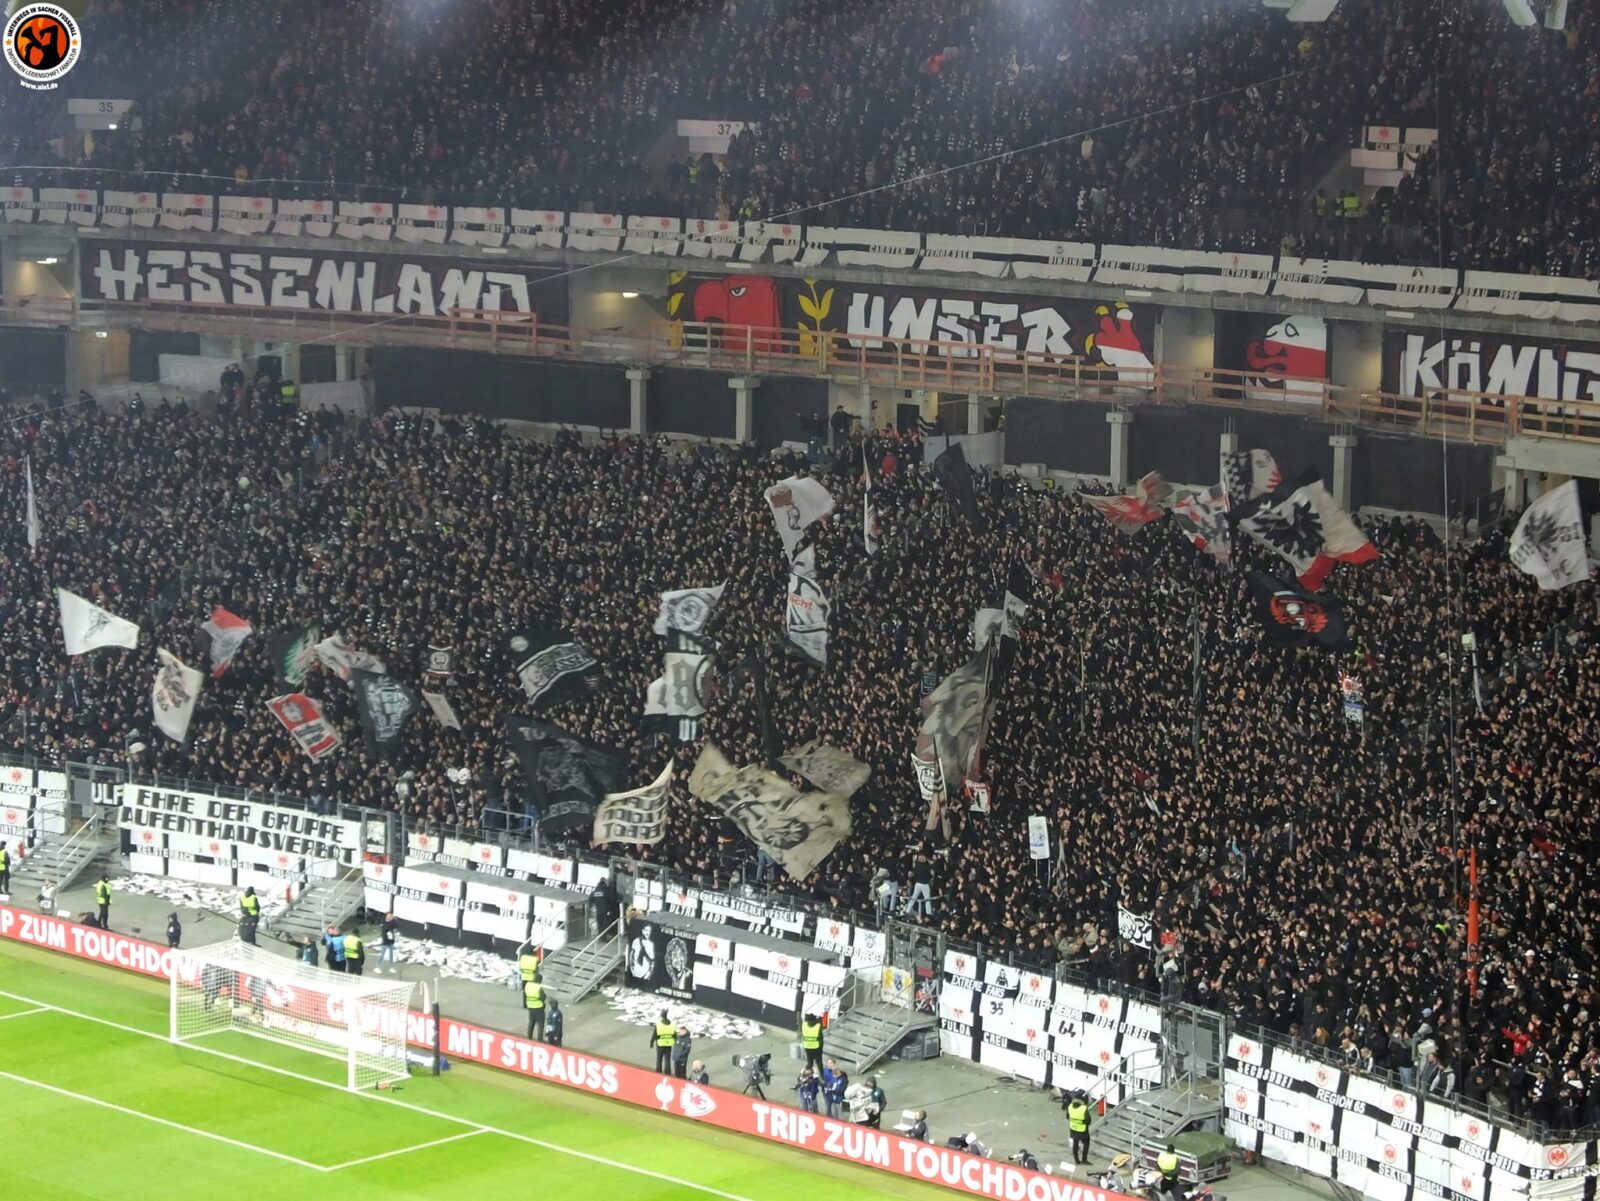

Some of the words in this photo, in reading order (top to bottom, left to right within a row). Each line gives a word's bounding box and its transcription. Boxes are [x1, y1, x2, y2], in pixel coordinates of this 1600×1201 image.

[98, 102, 114, 113] 35
[717, 123, 732, 136] 37
[1091, 258, 1122, 271] SZENE
[1129, 262, 1149, 273] 1995
[1221, 266, 1252, 279] ULTRAS
[1256, 270, 1304, 283] FRANKFURT
[94, 248, 532, 323] HESSENLAND
[847, 292, 1074, 364] UNSER
[137, 789, 195, 814] EHRE
[207, 800, 251, 823] DER
[261, 810, 344, 843] GRUPPE
[121, 806, 357, 864] AUFENTHALTSVERBOT
[668, 903, 697, 919] ULTRA
[700, 911, 727, 925] KAOS
[19, 915, 67, 950] ZUM
[951, 975, 984, 993] EXTREME
[985, 985, 1006, 998] FANS
[941, 1018, 972, 1037] FULDA
[983, 1031, 1008, 1049] CREW
[1058, 1020, 1076, 1038] 64
[1092, 1014, 1151, 1041] OBERURSEL
[448, 1022, 495, 1060] MIT
[500, 1037, 619, 1095] STRAUSS
[1315, 1087, 1353, 1111] REGION
[752, 1102, 815, 1146] TRIP
[822, 1120, 891, 1168] ZUM
[1247, 1114, 1274, 1135] SECHS
[1303, 1133, 1321, 1148] BAD
[1324, 1143, 1368, 1168] HOMBURG
